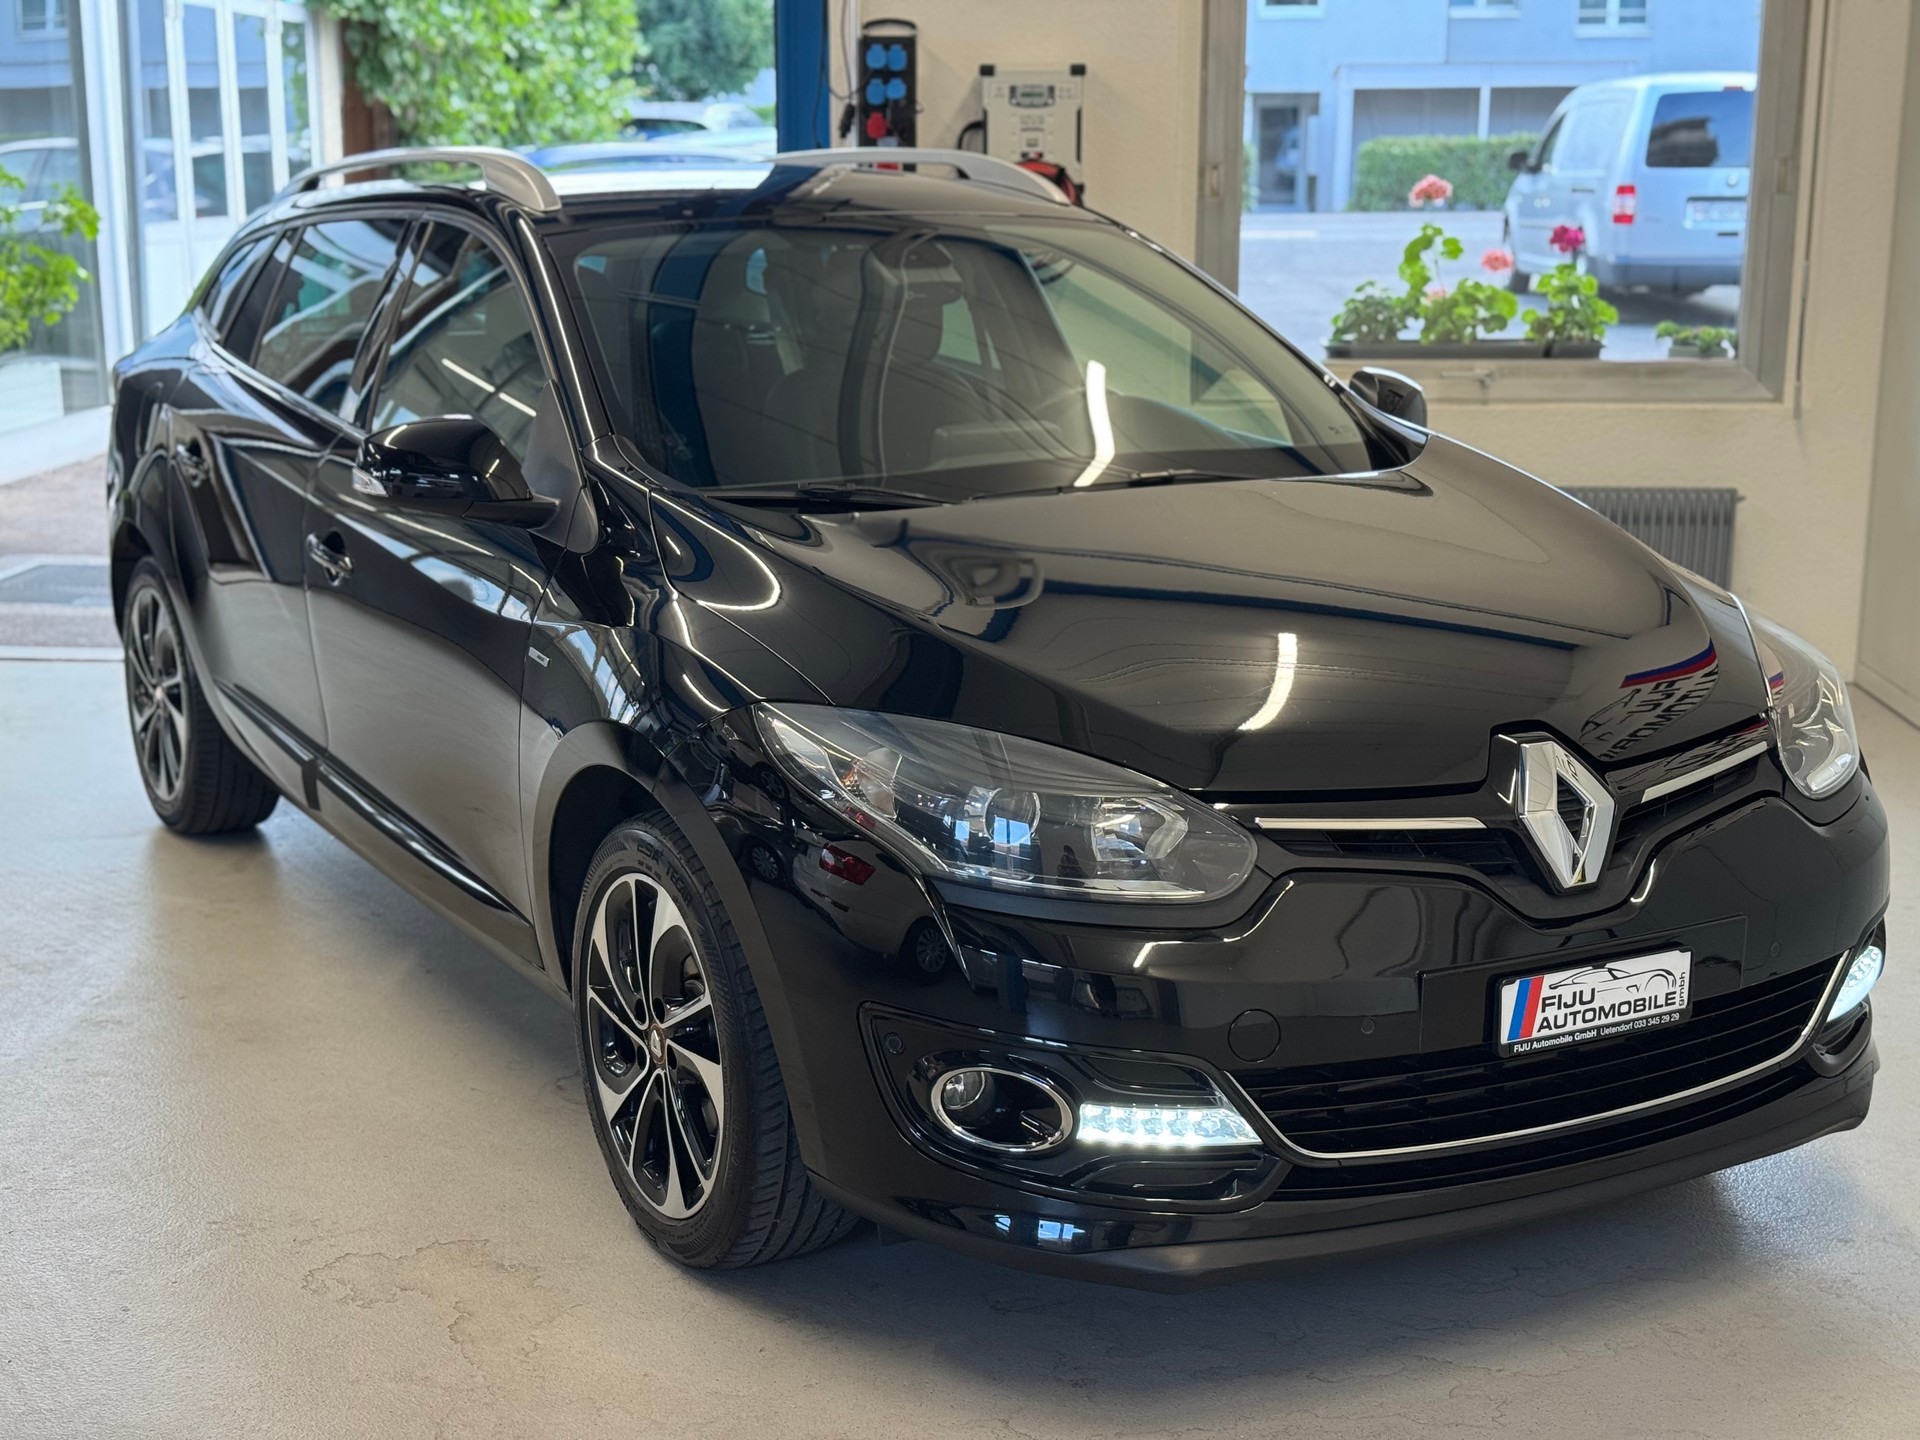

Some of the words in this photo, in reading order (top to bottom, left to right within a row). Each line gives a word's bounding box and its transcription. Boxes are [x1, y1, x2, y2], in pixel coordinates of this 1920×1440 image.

[1541, 987, 1596, 1014] FIJU
[1678, 971, 1686, 1007] gmbh
[1536, 990, 1677, 1033] AUTOMOBILE
[1513, 1042, 1532, 1053] FIJU
[1532, 1035, 1573, 1048] Automobile
[1574, 1029, 1597, 1041] GmbH
[1600, 1021, 1634, 1036] Uetendorf
[1634, 1019, 1647, 1029] 033
[1647, 1016, 1661, 1027] 345
[1661, 1014, 1670, 1025] 29
[1671, 1012, 1680, 1023] 29
